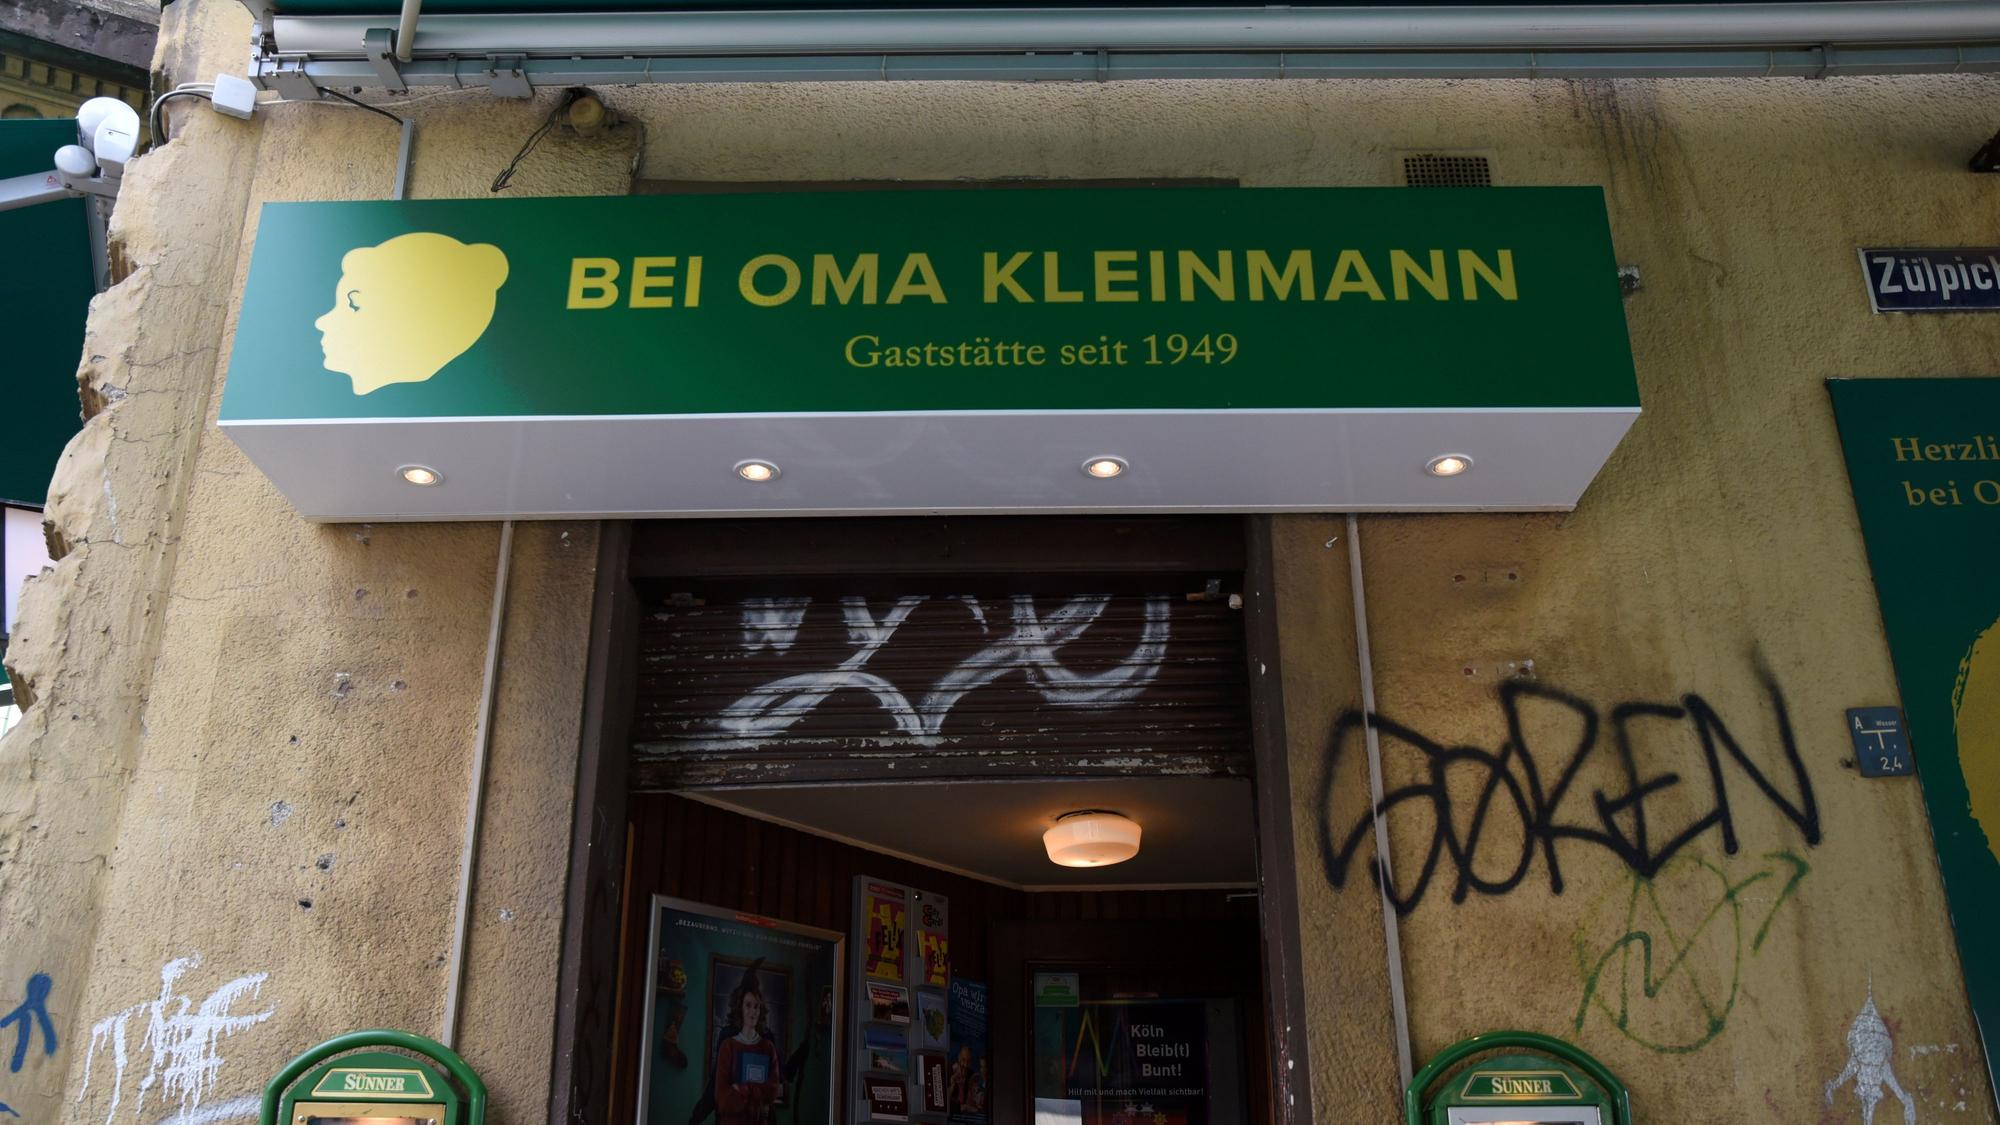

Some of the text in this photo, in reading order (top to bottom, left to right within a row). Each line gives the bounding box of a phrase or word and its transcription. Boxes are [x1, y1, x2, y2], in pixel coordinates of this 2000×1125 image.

[566, 248, 1520, 311] BEI OMA KLEINMANN
[844, 334, 1240, 369] Gaststätte seit 1949
[1891, 434, 2000, 461] Herzli
[1903, 480, 1963, 506] bei
[1855, 716, 1863, 730] A
[1131, 1024, 1164, 1038] Köln
[1136, 1043, 1190, 1058] Bleib(t)
[1142, 1063, 1182, 1077] Bunt!
[343, 1071, 405, 1092] SÜNNER
[1491, 1076, 1552, 1094] SÜNNER
[1068, 1087, 1204, 1096] Hilf mit und mach Vielfalt sichtbar!
